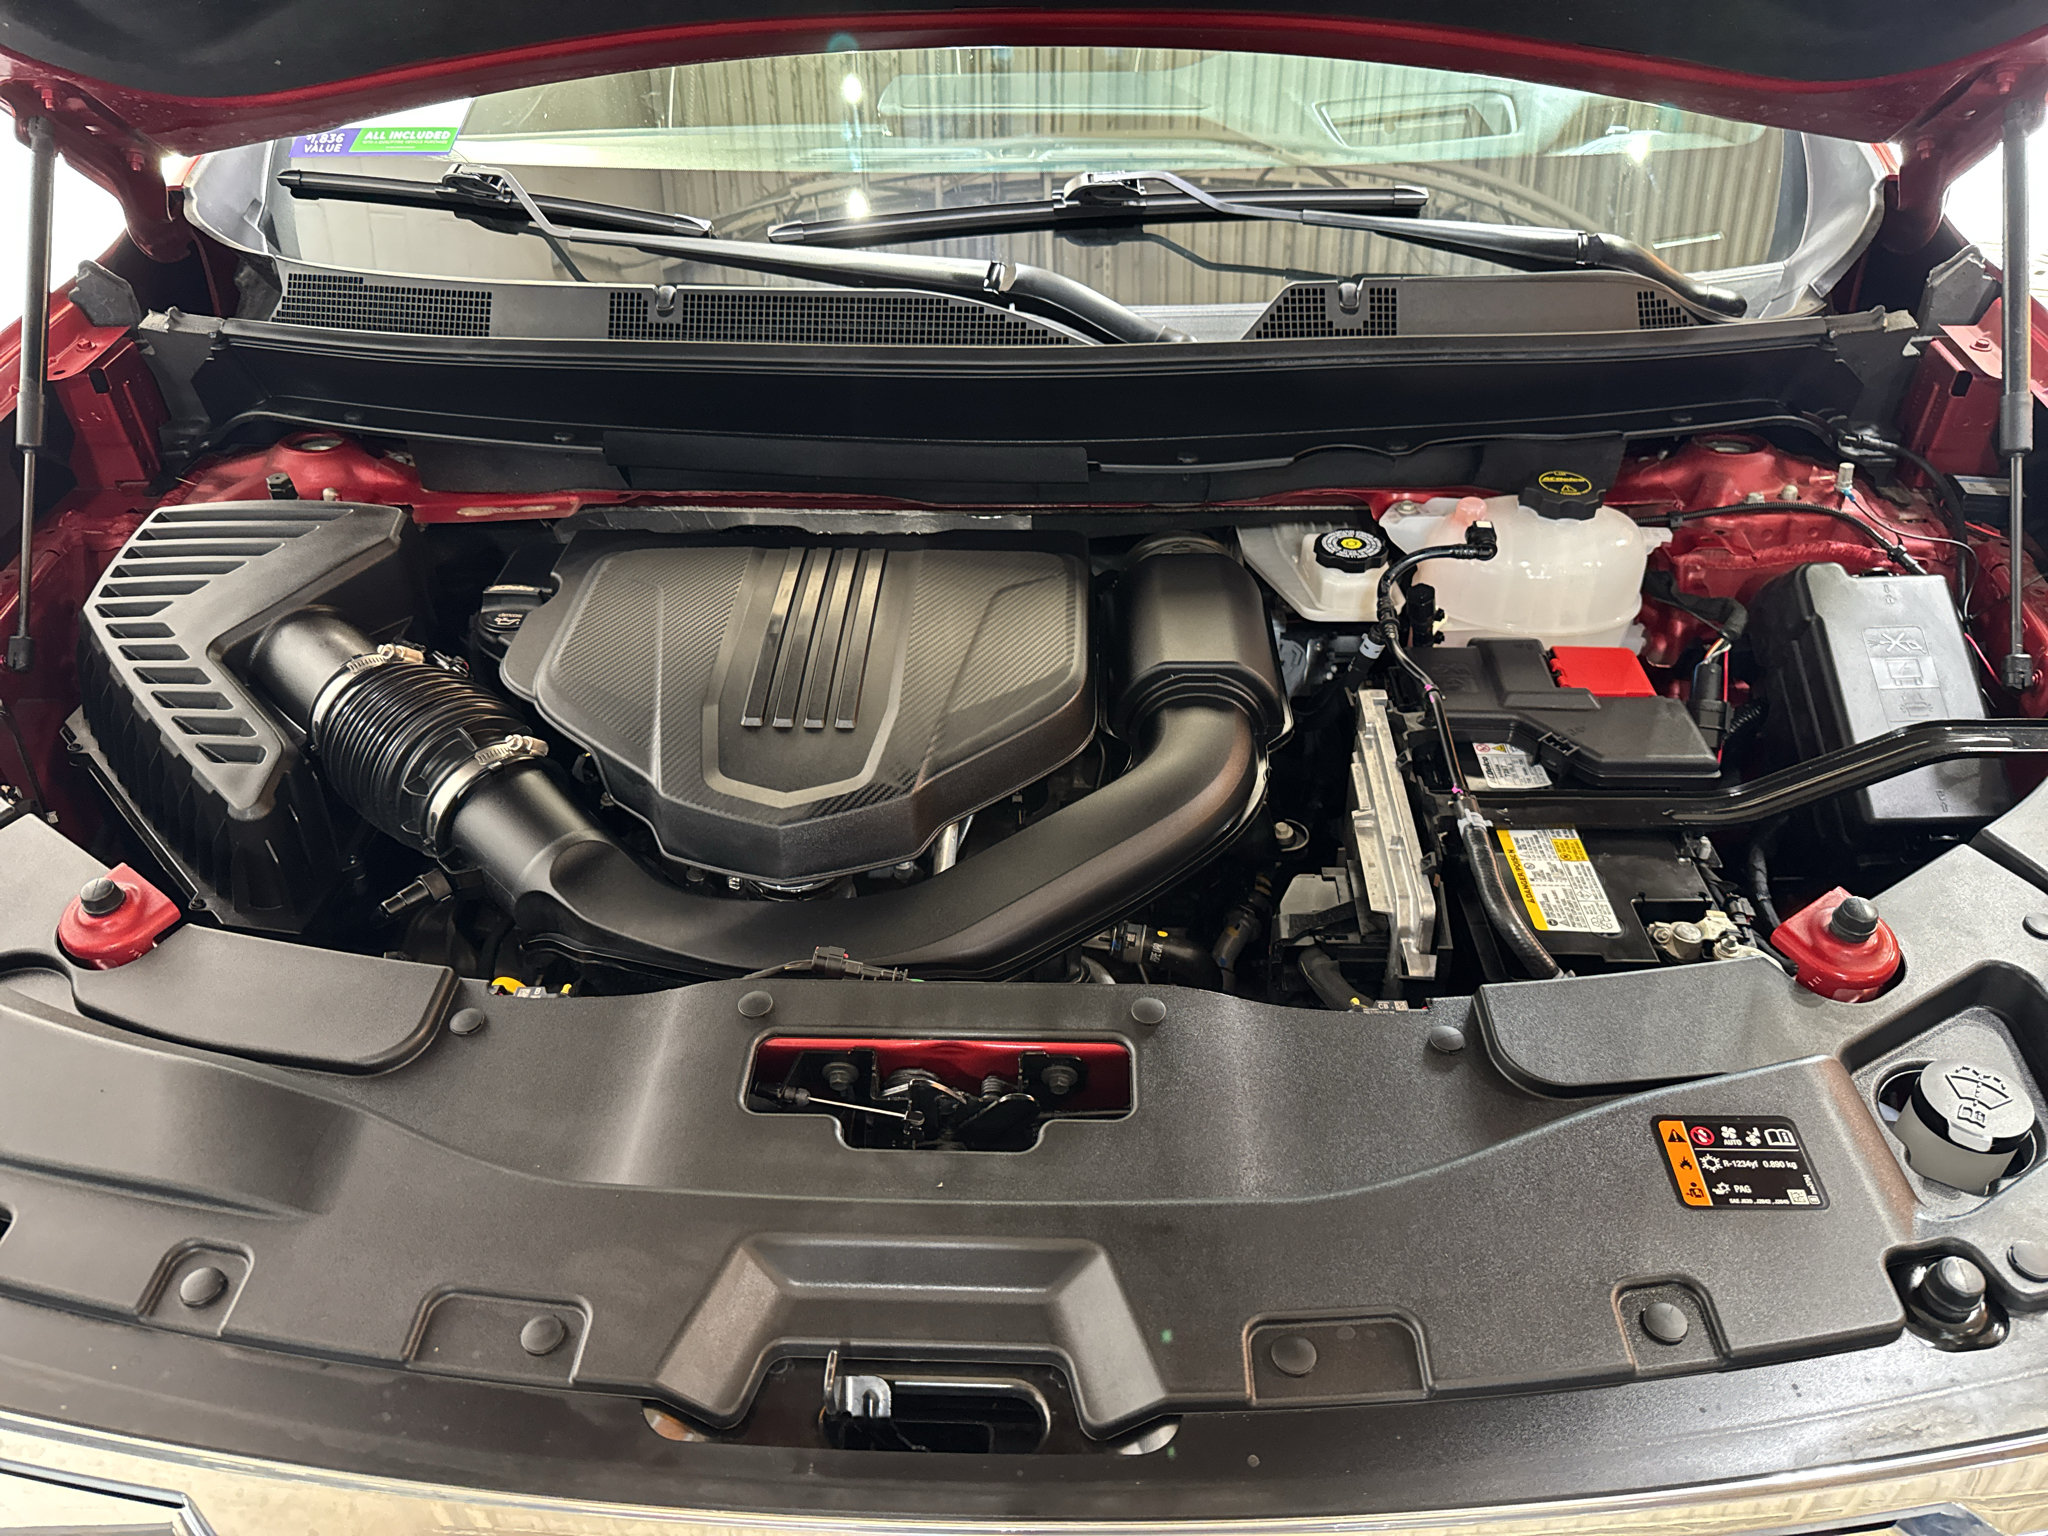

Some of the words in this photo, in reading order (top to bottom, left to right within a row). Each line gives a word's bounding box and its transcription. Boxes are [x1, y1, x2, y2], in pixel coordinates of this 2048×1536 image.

[364, 131, 386, 140] ALL
[389, 131, 451, 140] INCLUDED
[304, 144, 342, 153] VALUE
[1722, 1160, 1758, 1169] R-1234yf
[1785, 1161, 1798, 1170] kg
[1733, 1184, 1752, 1193] PAG
